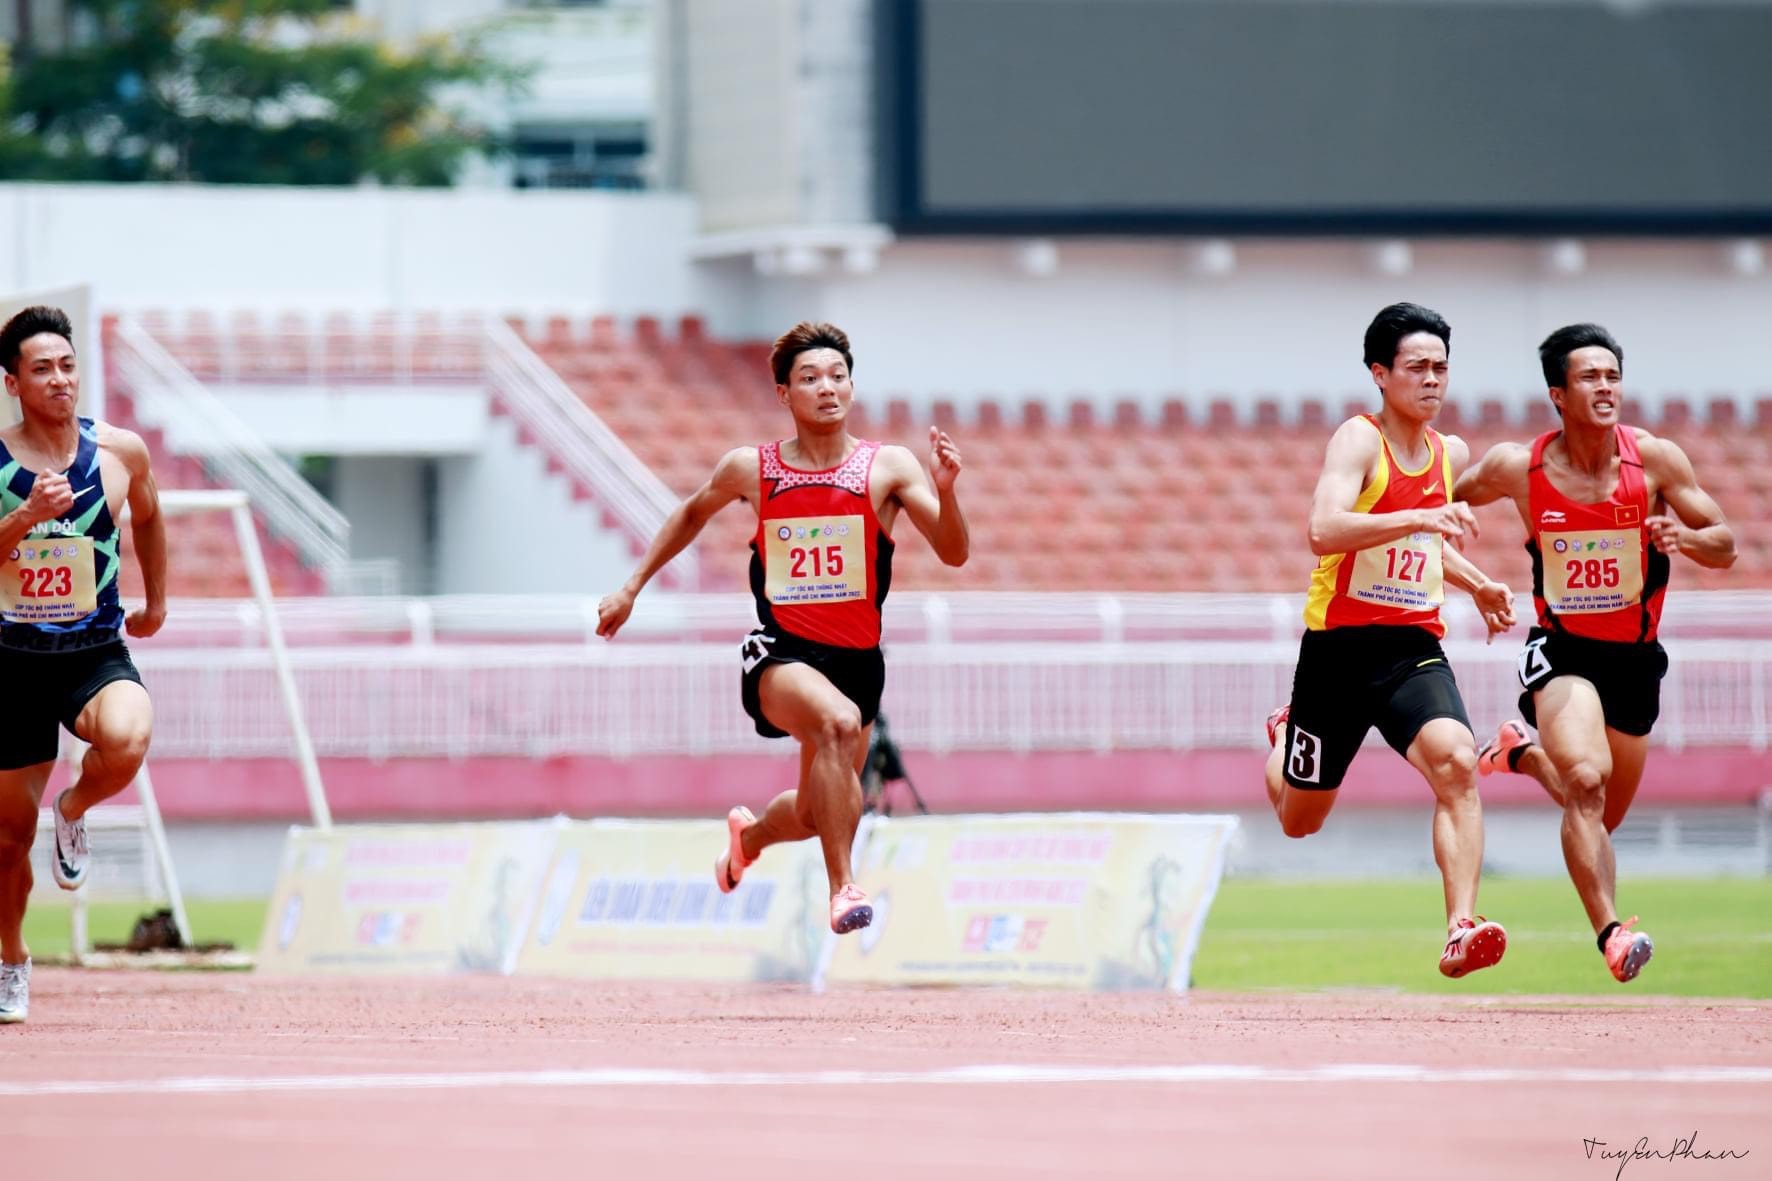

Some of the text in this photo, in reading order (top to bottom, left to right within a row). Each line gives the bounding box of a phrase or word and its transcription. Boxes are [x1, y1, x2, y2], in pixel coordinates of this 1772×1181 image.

[790, 546, 843, 577] 215
[1386, 547, 1427, 582] 127
[1566, 558, 1620, 589] 285
[19, 566, 72, 597] 223
[1293, 731, 1316, 779] 3
